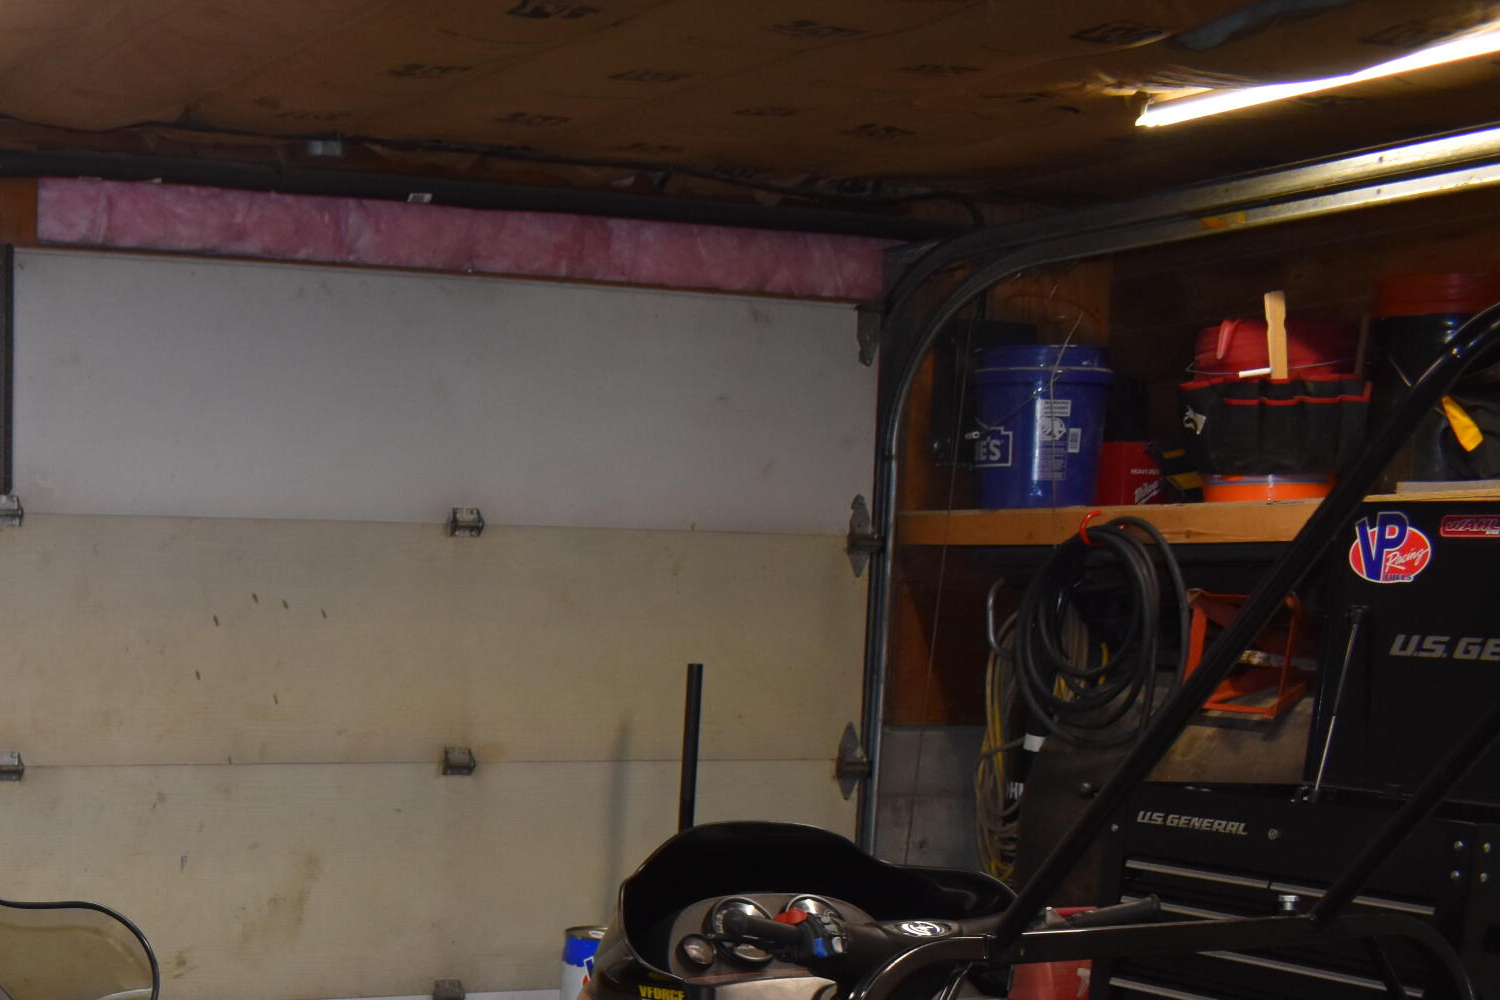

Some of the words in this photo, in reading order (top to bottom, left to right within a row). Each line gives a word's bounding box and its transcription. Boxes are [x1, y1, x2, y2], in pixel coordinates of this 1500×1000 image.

[1355, 511, 1409, 583] VP
[1385, 548, 1429, 573] Racing
[1165, 814, 1249, 836] GENERAL
